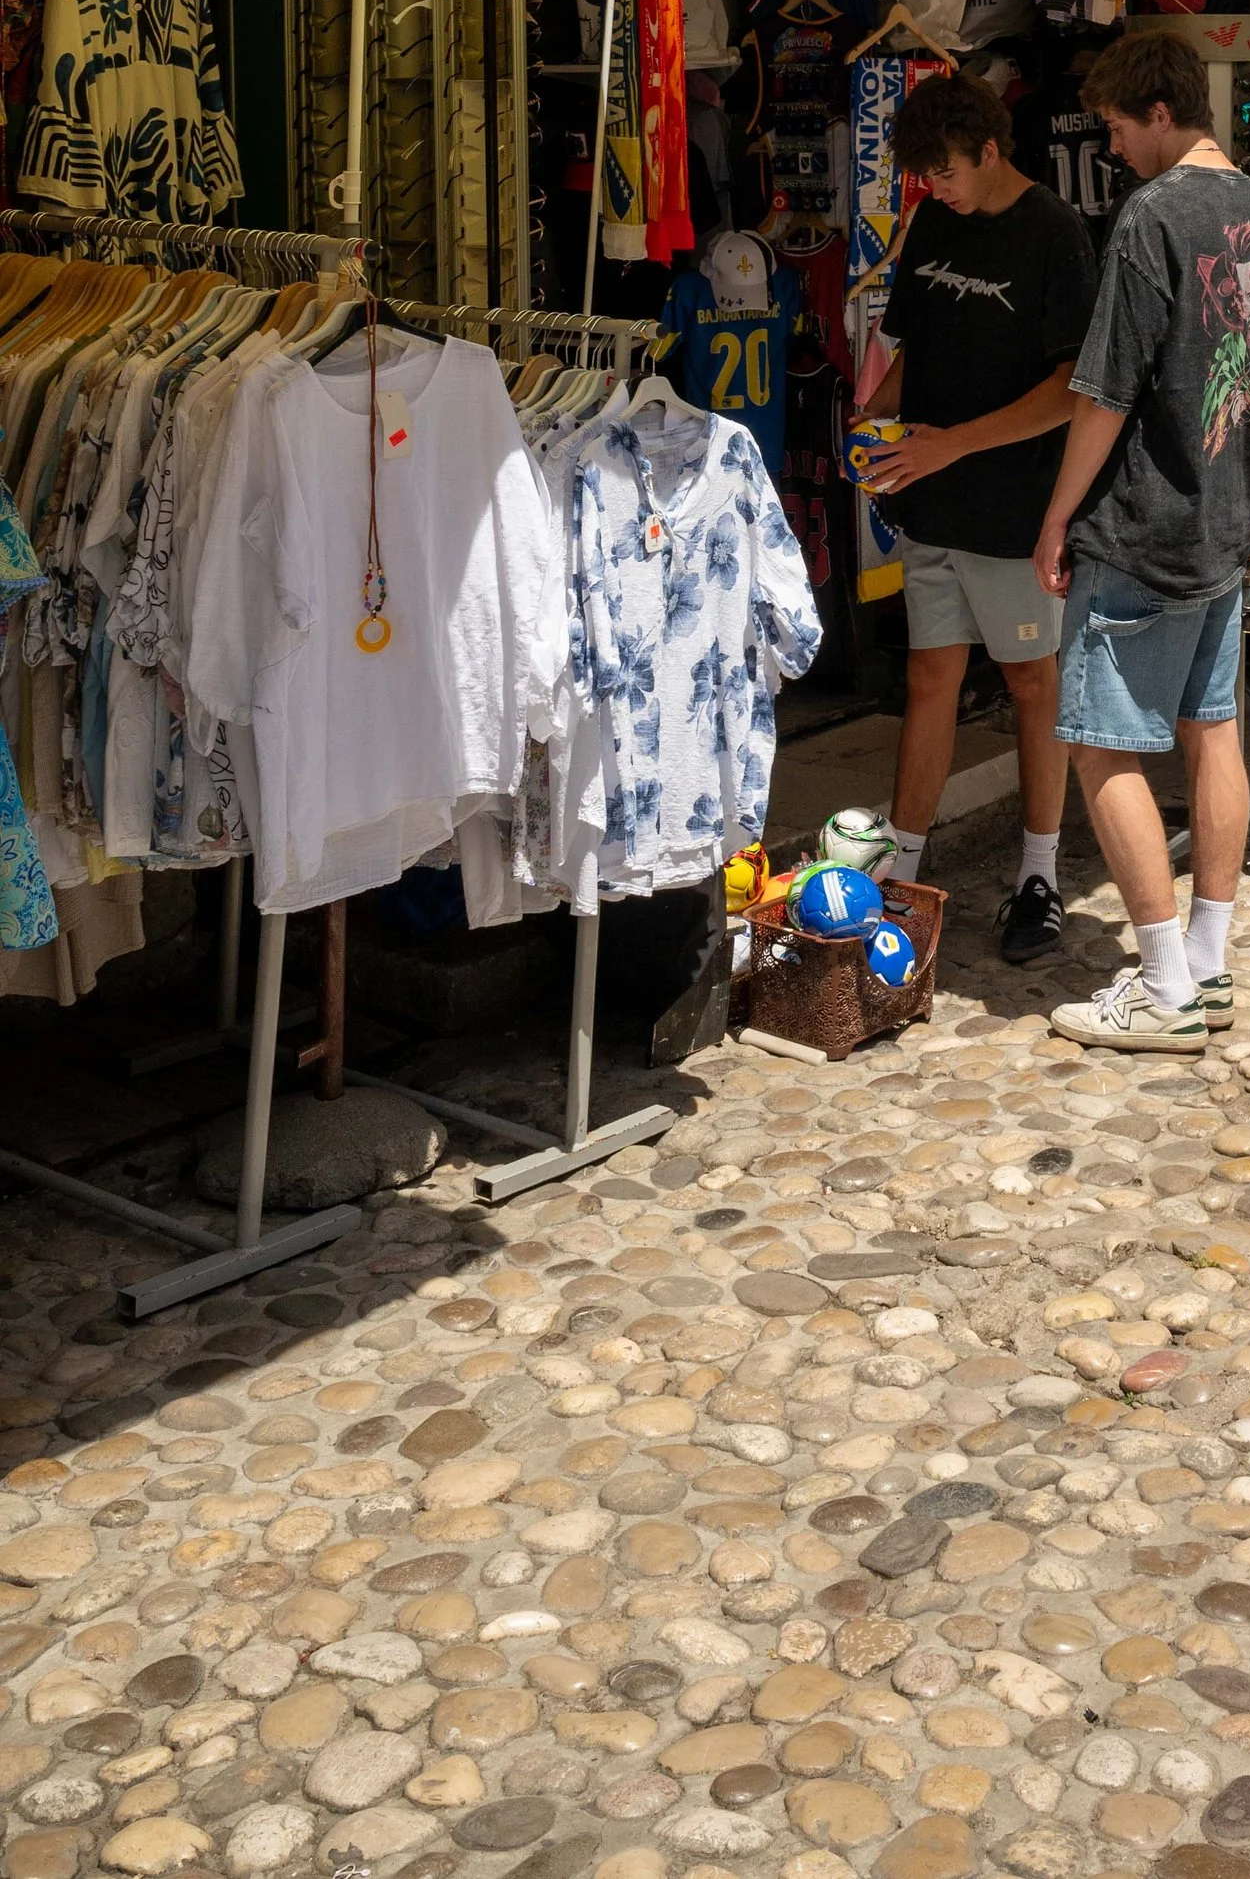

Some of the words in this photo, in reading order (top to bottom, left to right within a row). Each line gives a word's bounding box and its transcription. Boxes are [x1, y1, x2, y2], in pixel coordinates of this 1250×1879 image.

[1049, 139, 1114, 217] 10
[914, 260, 1016, 312] CYBERPUNK
[710, 327, 771, 411] 20
